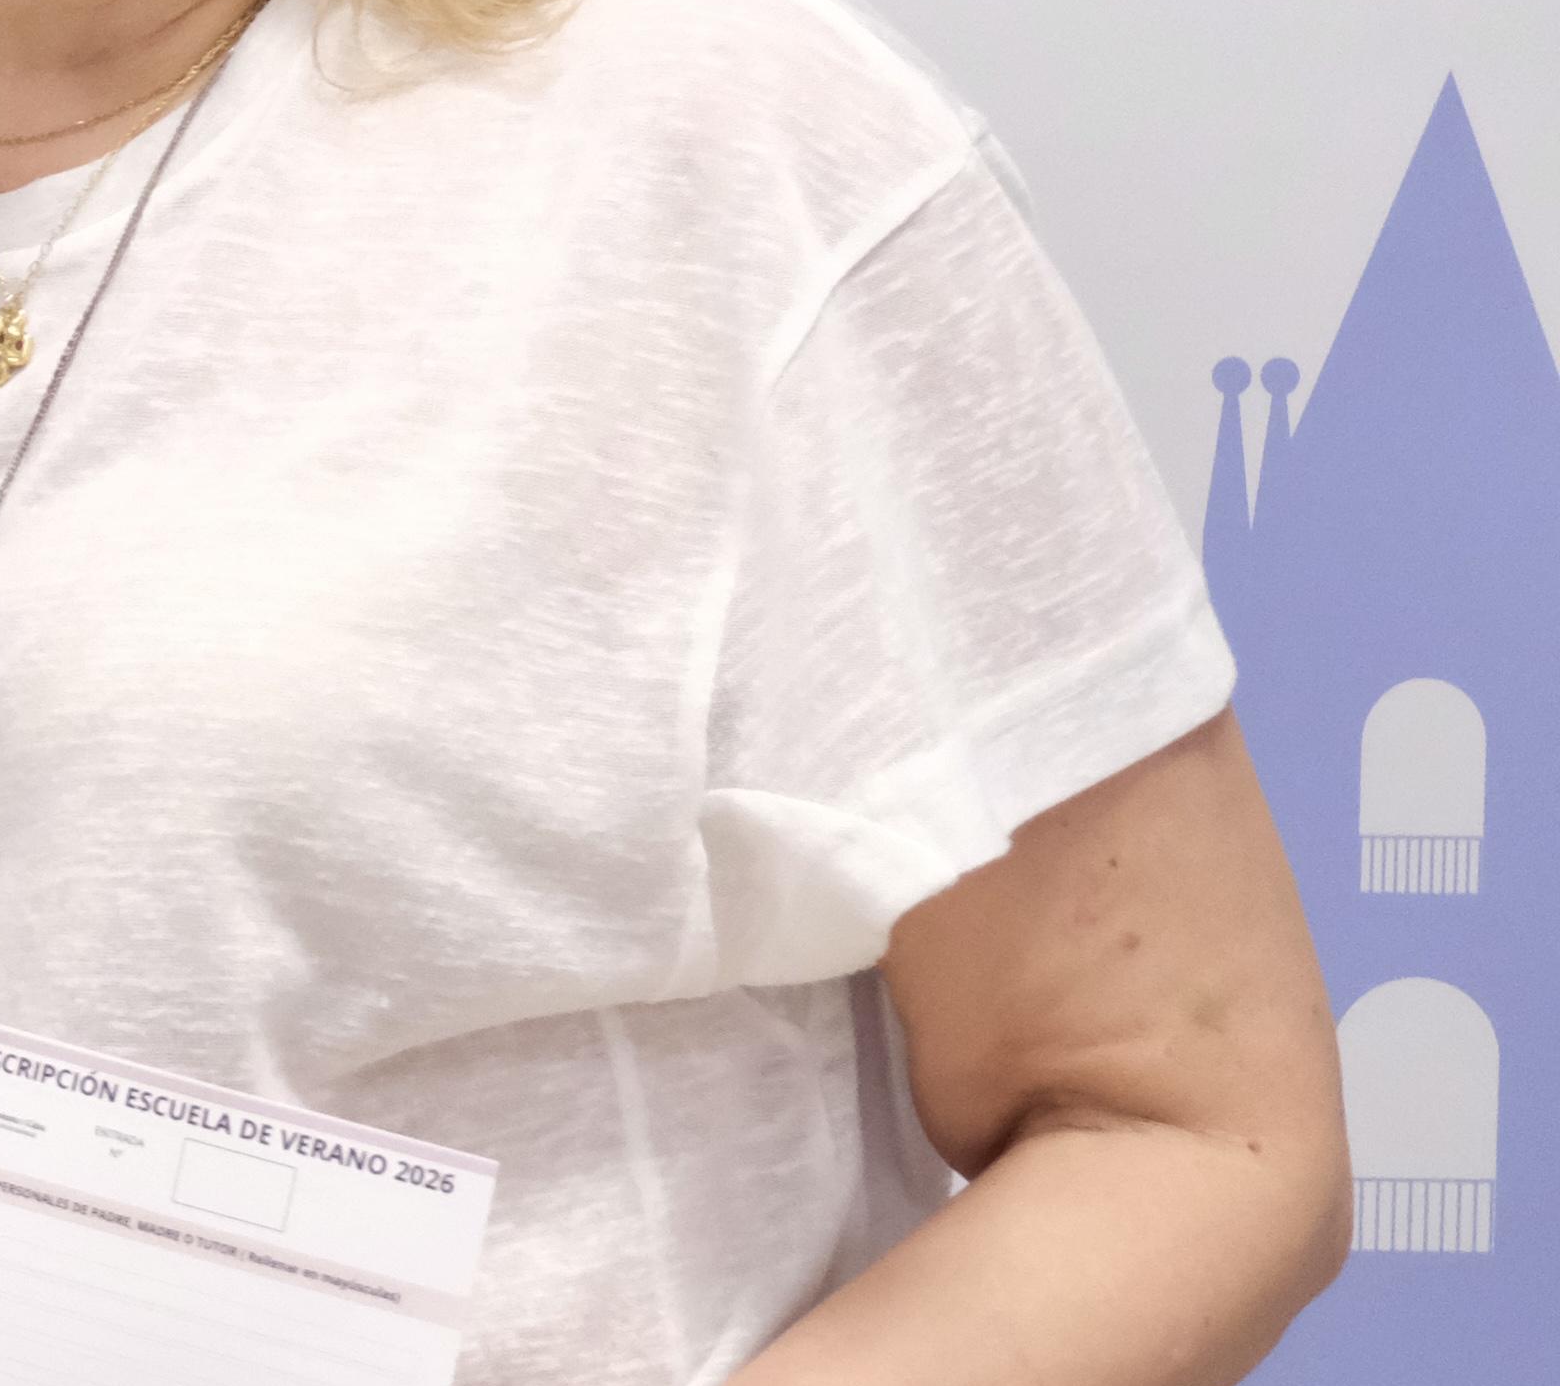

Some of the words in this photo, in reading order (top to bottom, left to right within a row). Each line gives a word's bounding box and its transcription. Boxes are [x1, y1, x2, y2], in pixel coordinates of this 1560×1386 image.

[125, 1087, 231, 1135] ESCUELA
[239, 1118, 273, 1146] DE
[281, 1129, 387, 1176] VERANO
[394, 1160, 455, 1194] 2026
